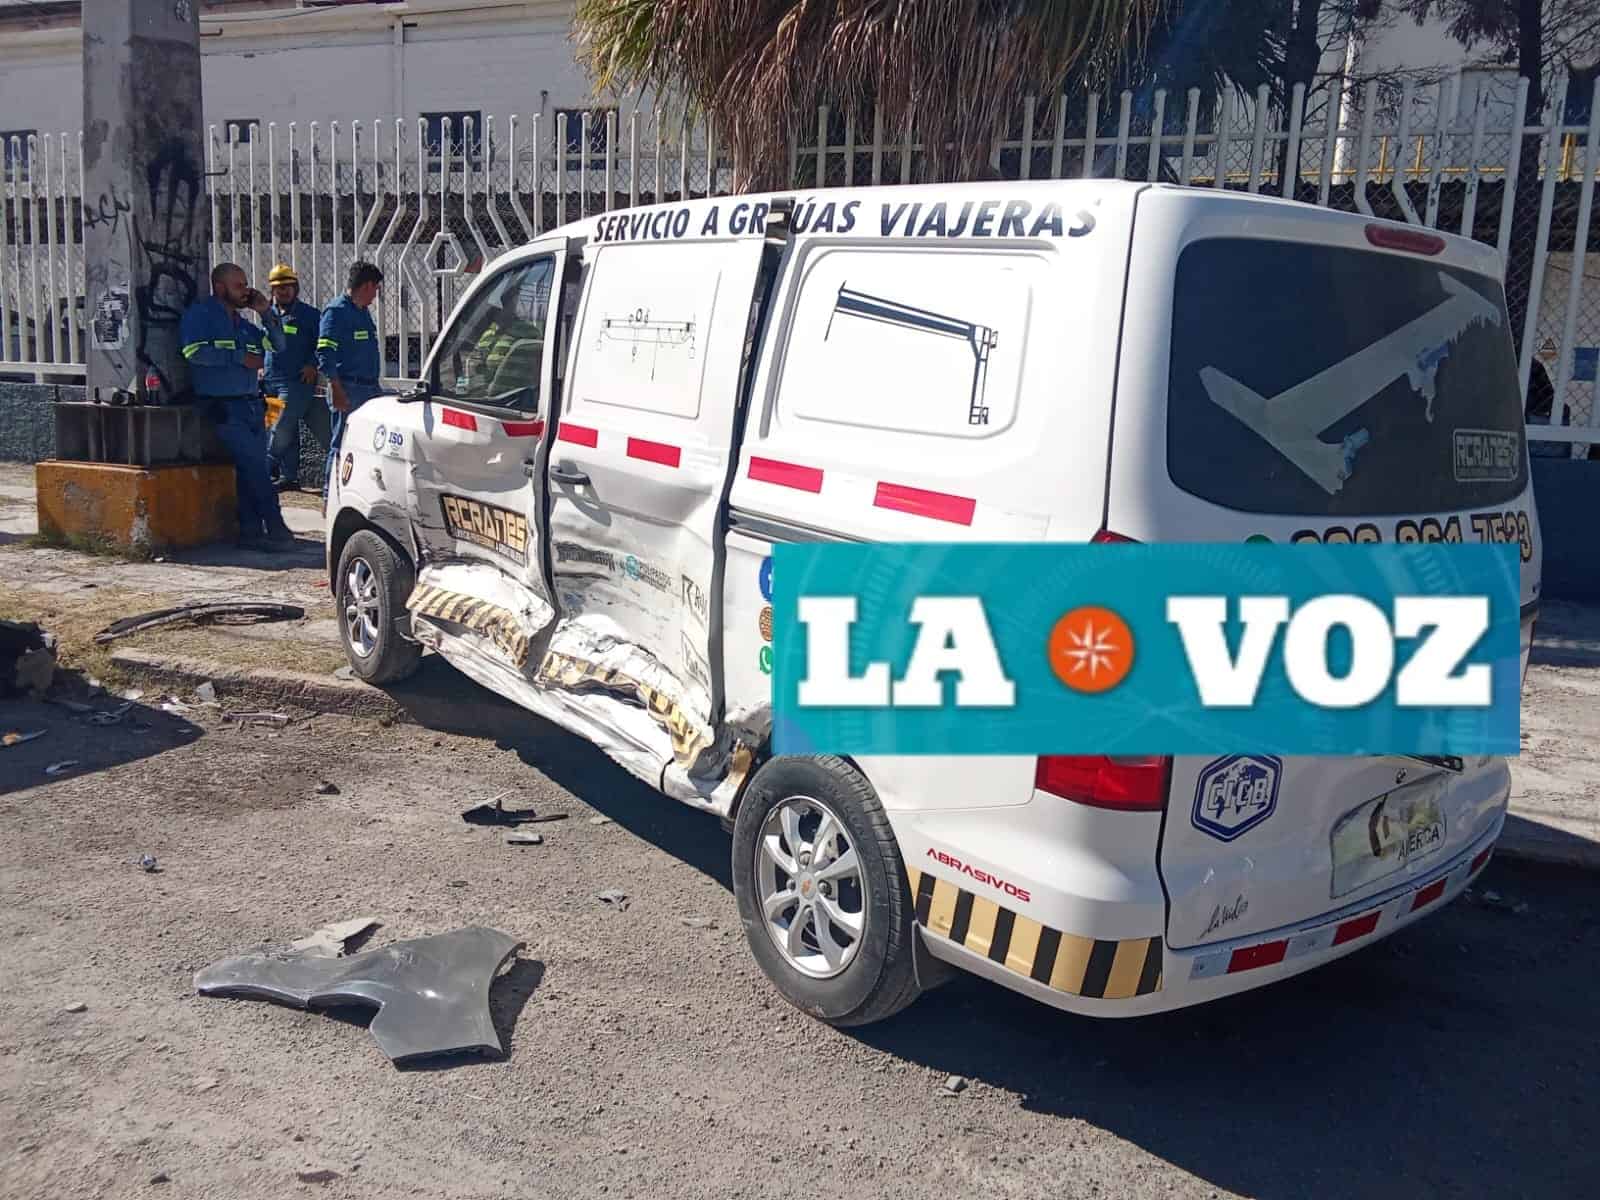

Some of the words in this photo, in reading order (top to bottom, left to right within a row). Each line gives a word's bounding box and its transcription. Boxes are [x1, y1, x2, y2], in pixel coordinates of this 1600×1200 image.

[594, 207, 690, 242] SERVICIO
[701, 208, 719, 236] A
[880, 198, 1100, 238] VIAJERAS
[388, 431, 404, 446] ISO
[926, 847, 1031, 902] ABRASIVOS
